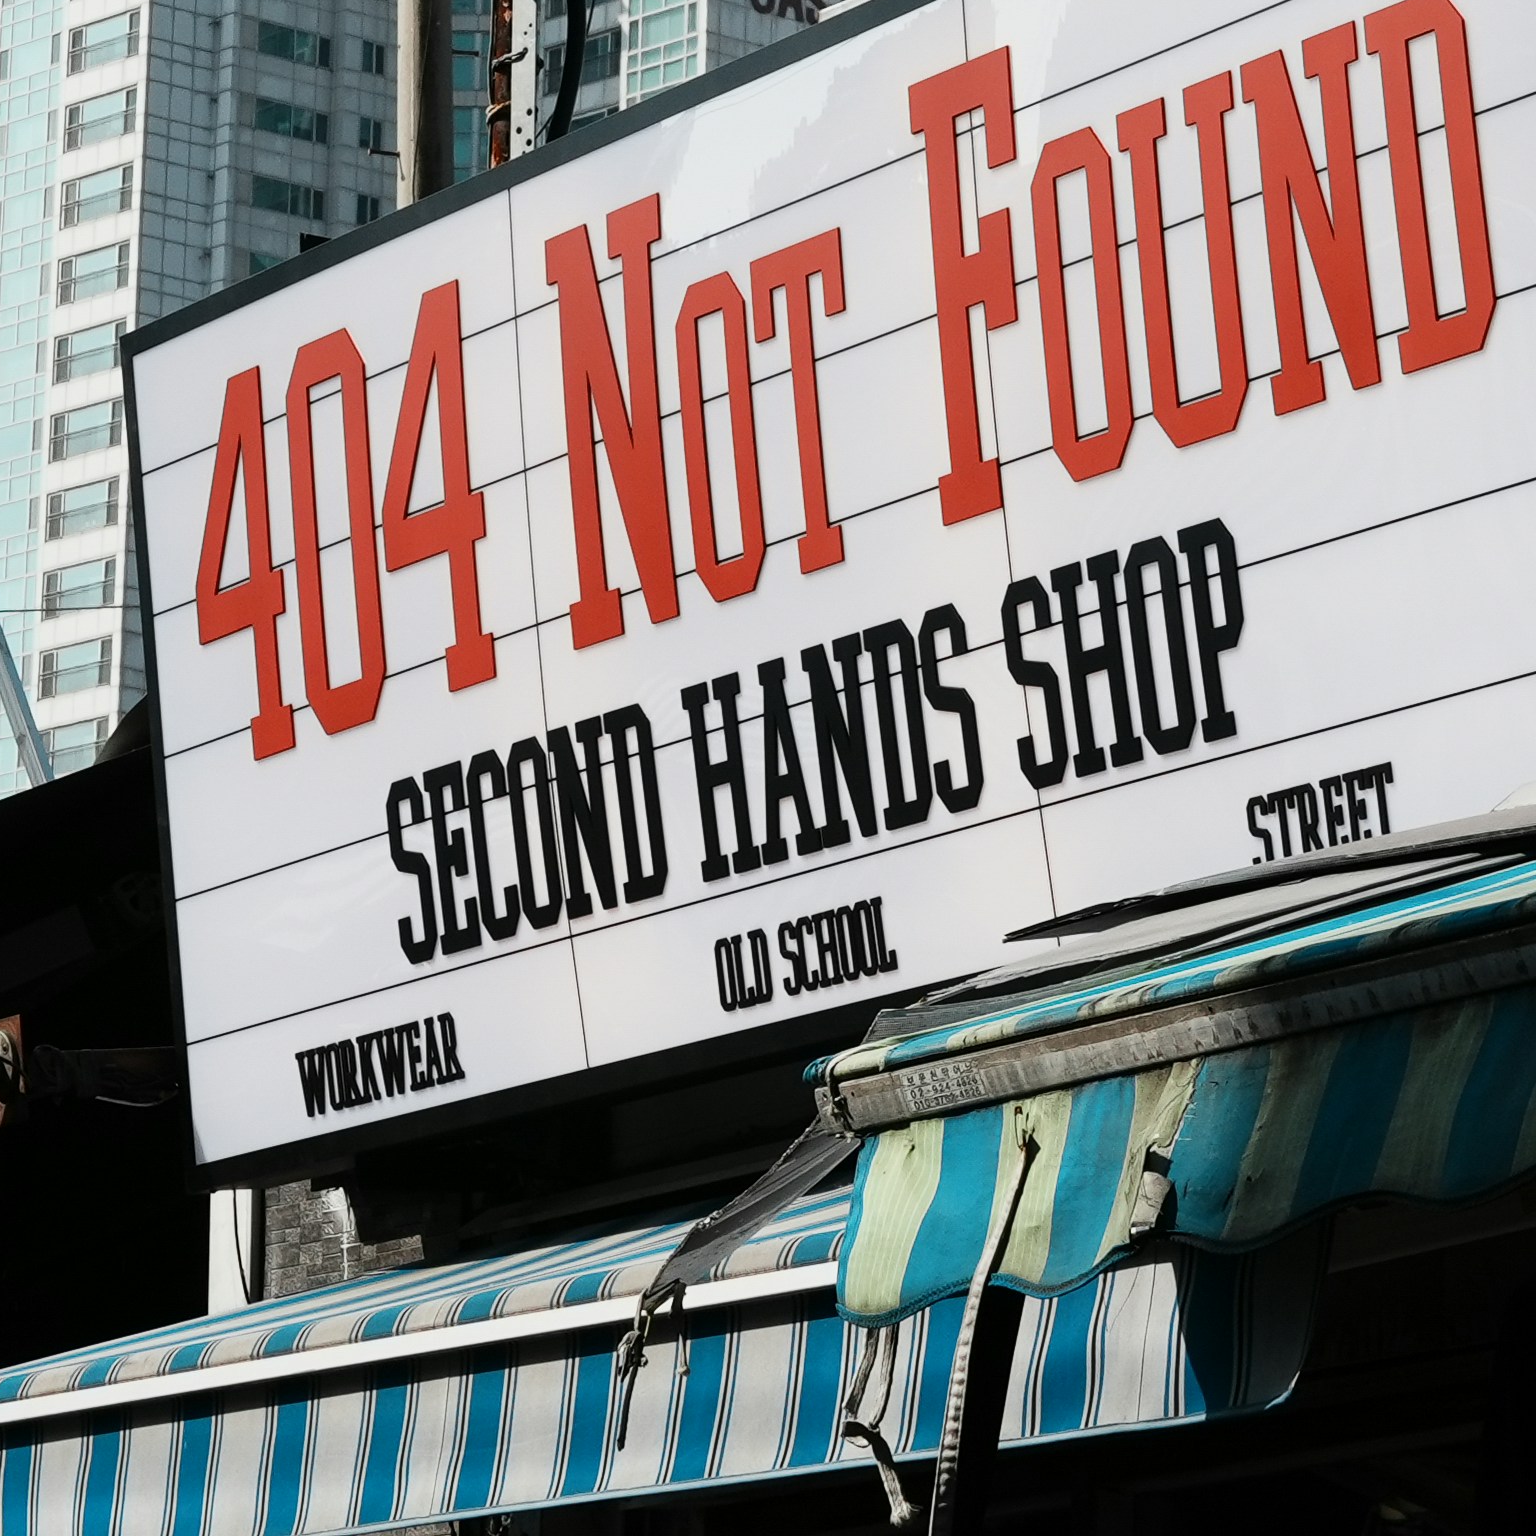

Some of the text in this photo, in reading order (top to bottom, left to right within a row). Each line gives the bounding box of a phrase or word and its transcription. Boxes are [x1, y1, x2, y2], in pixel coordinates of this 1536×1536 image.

[196, 278, 497, 761] 404
[386, 518, 1244, 965] SECOND HANDS SHOP
[1246, 761, 1394, 865] STREET
[714, 896, 898, 1012] OLD SCHOOL
[295, 1012, 465, 1118] WORKWEAR
